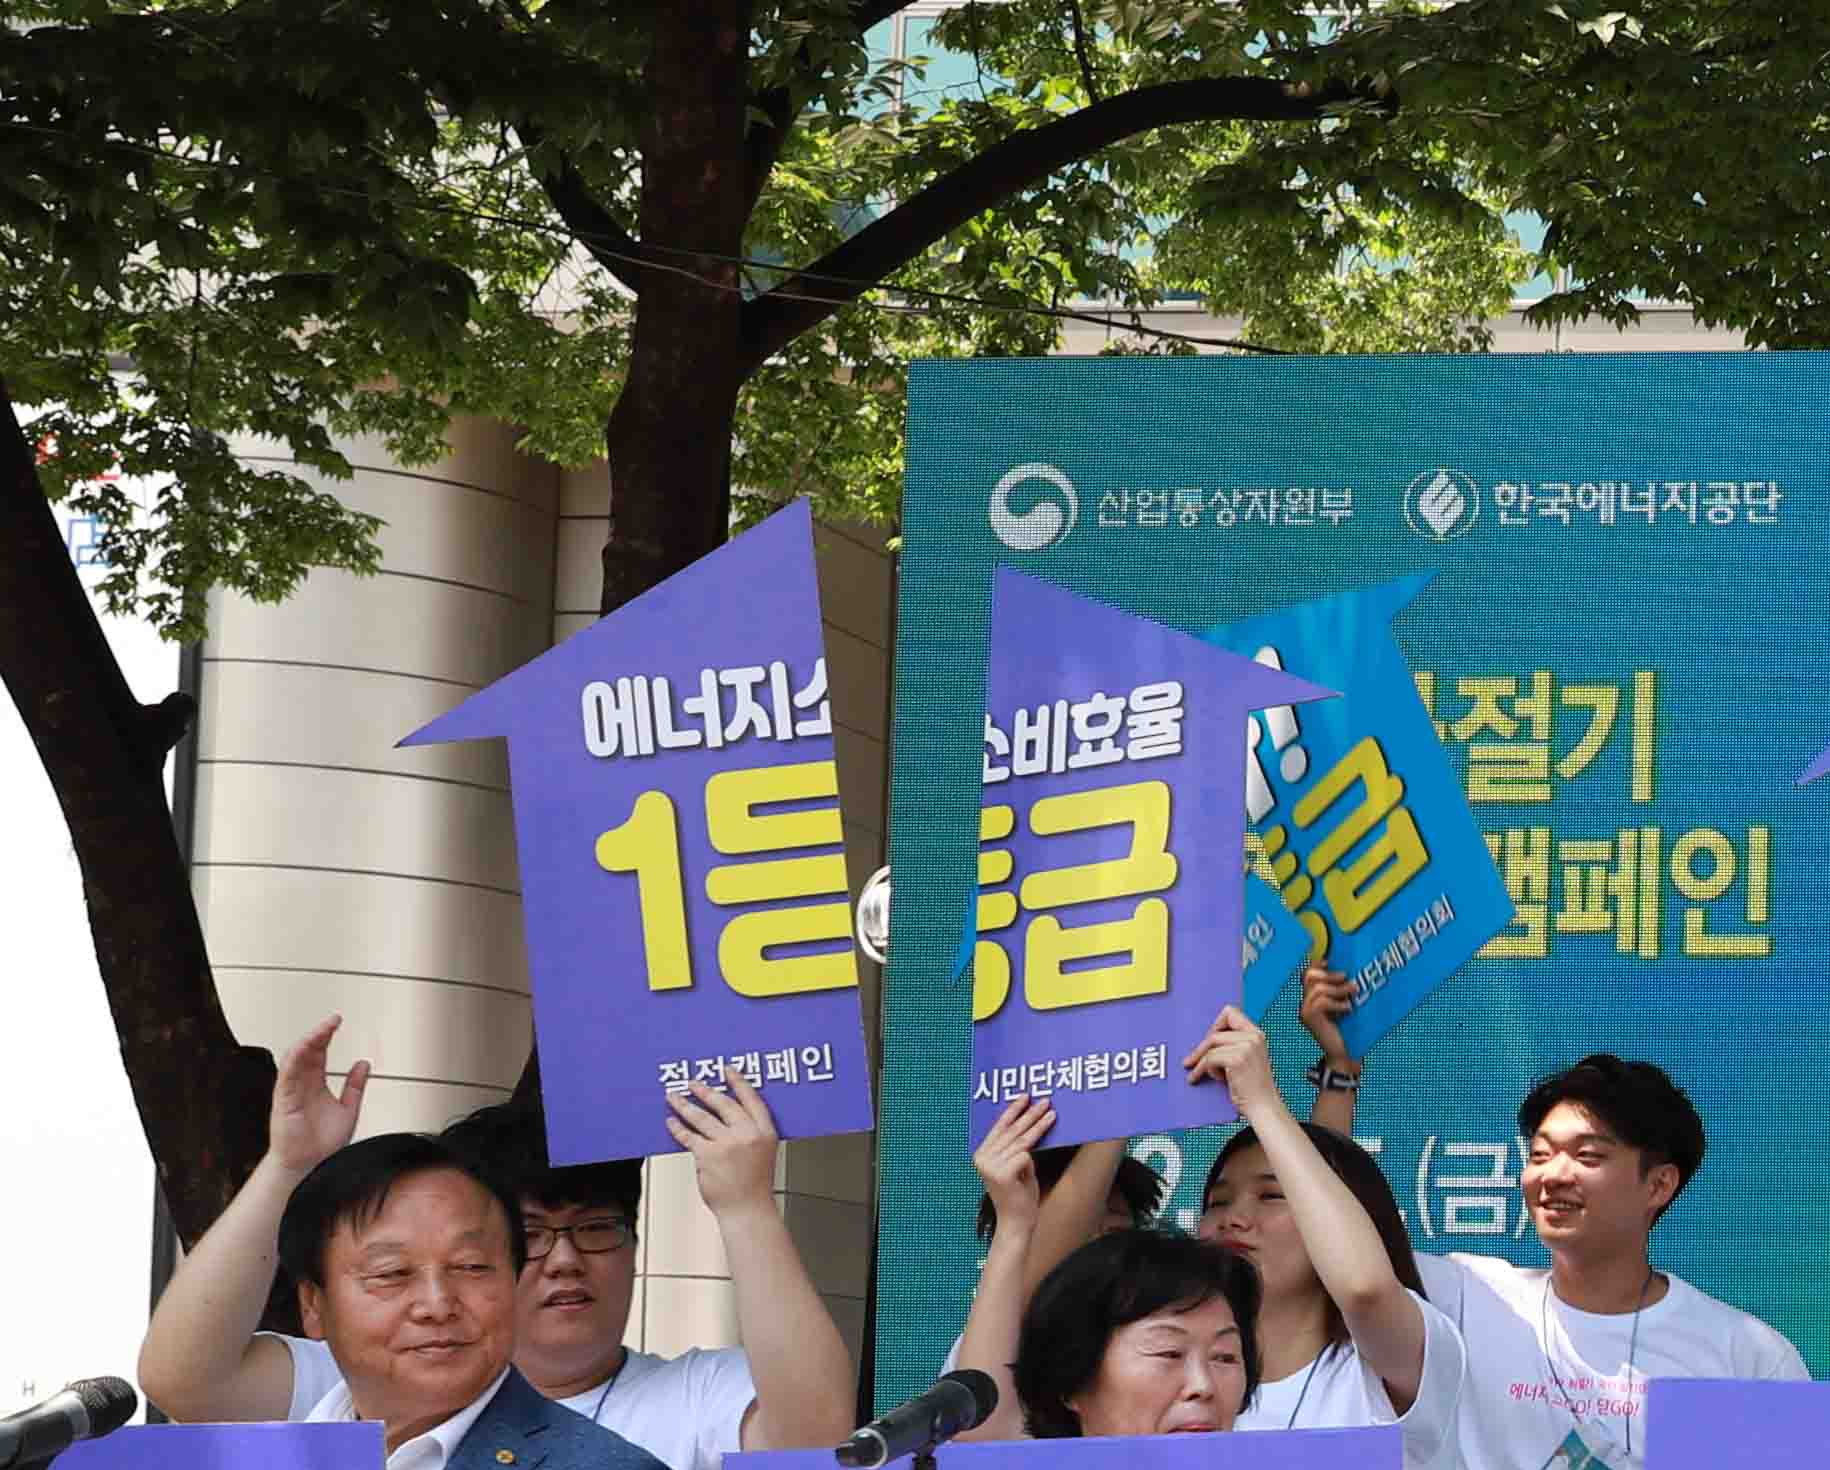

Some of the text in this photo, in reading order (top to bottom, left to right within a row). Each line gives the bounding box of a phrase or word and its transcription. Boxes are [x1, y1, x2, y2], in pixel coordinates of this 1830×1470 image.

[1096, 486, 1354, 528] 산업통상자원부
[1493, 483, 1782, 525] 한국에너지공단
[974, 1045, 1167, 1103] 시민단체협의회
